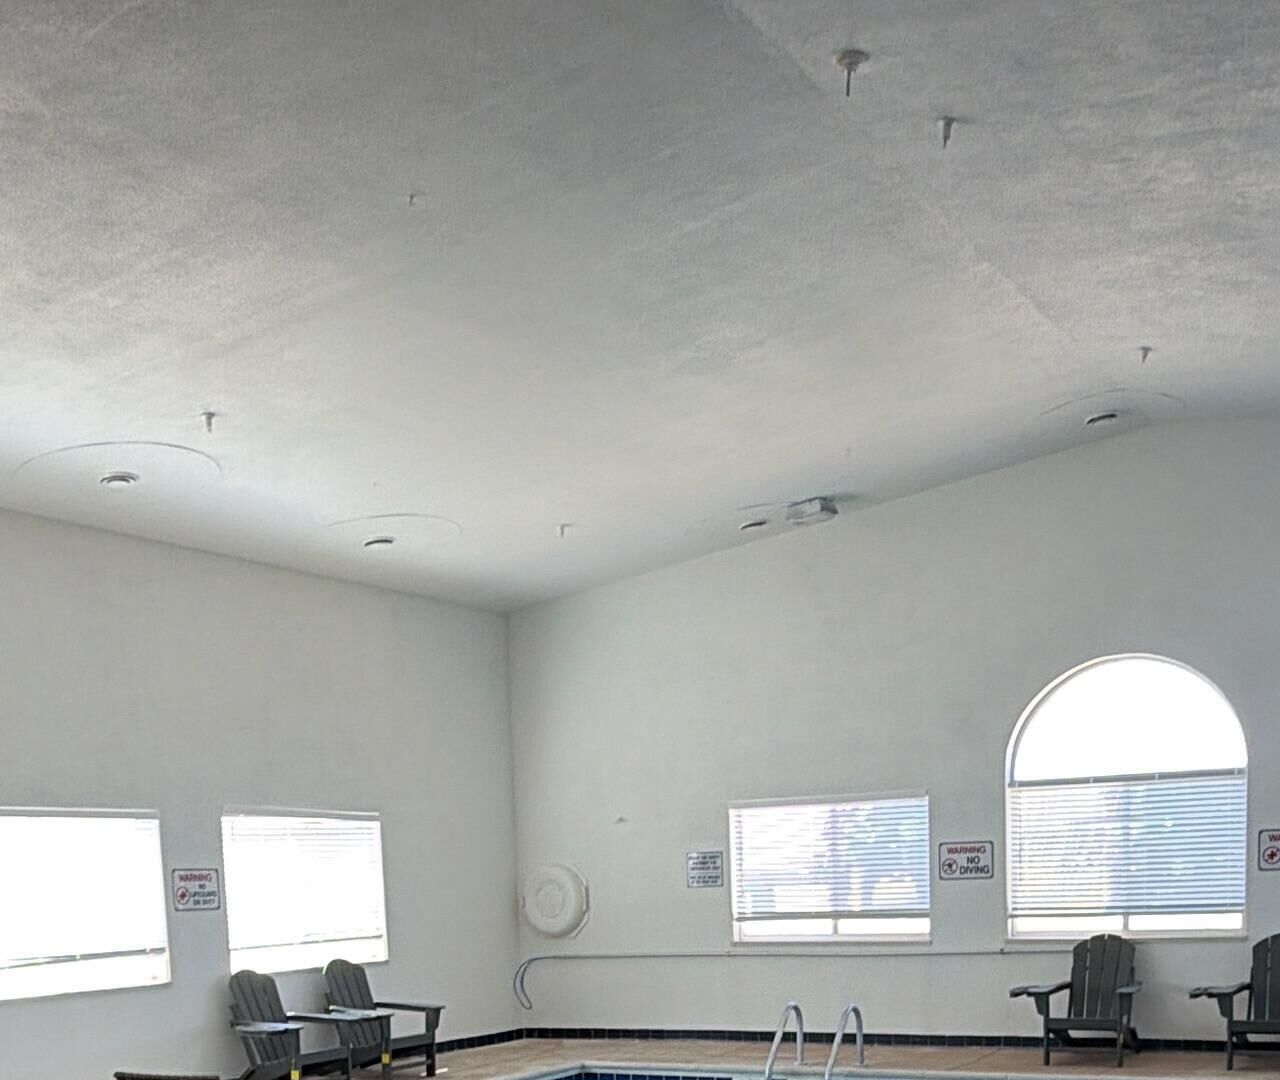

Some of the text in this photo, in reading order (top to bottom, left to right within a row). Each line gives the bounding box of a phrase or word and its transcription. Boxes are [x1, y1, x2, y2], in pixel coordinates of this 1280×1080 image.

[946, 845, 986, 855] WARNING
[966, 855, 981, 865] NO
[959, 864, 990, 875] DIVING
[178, 873, 213, 882] WARNING
